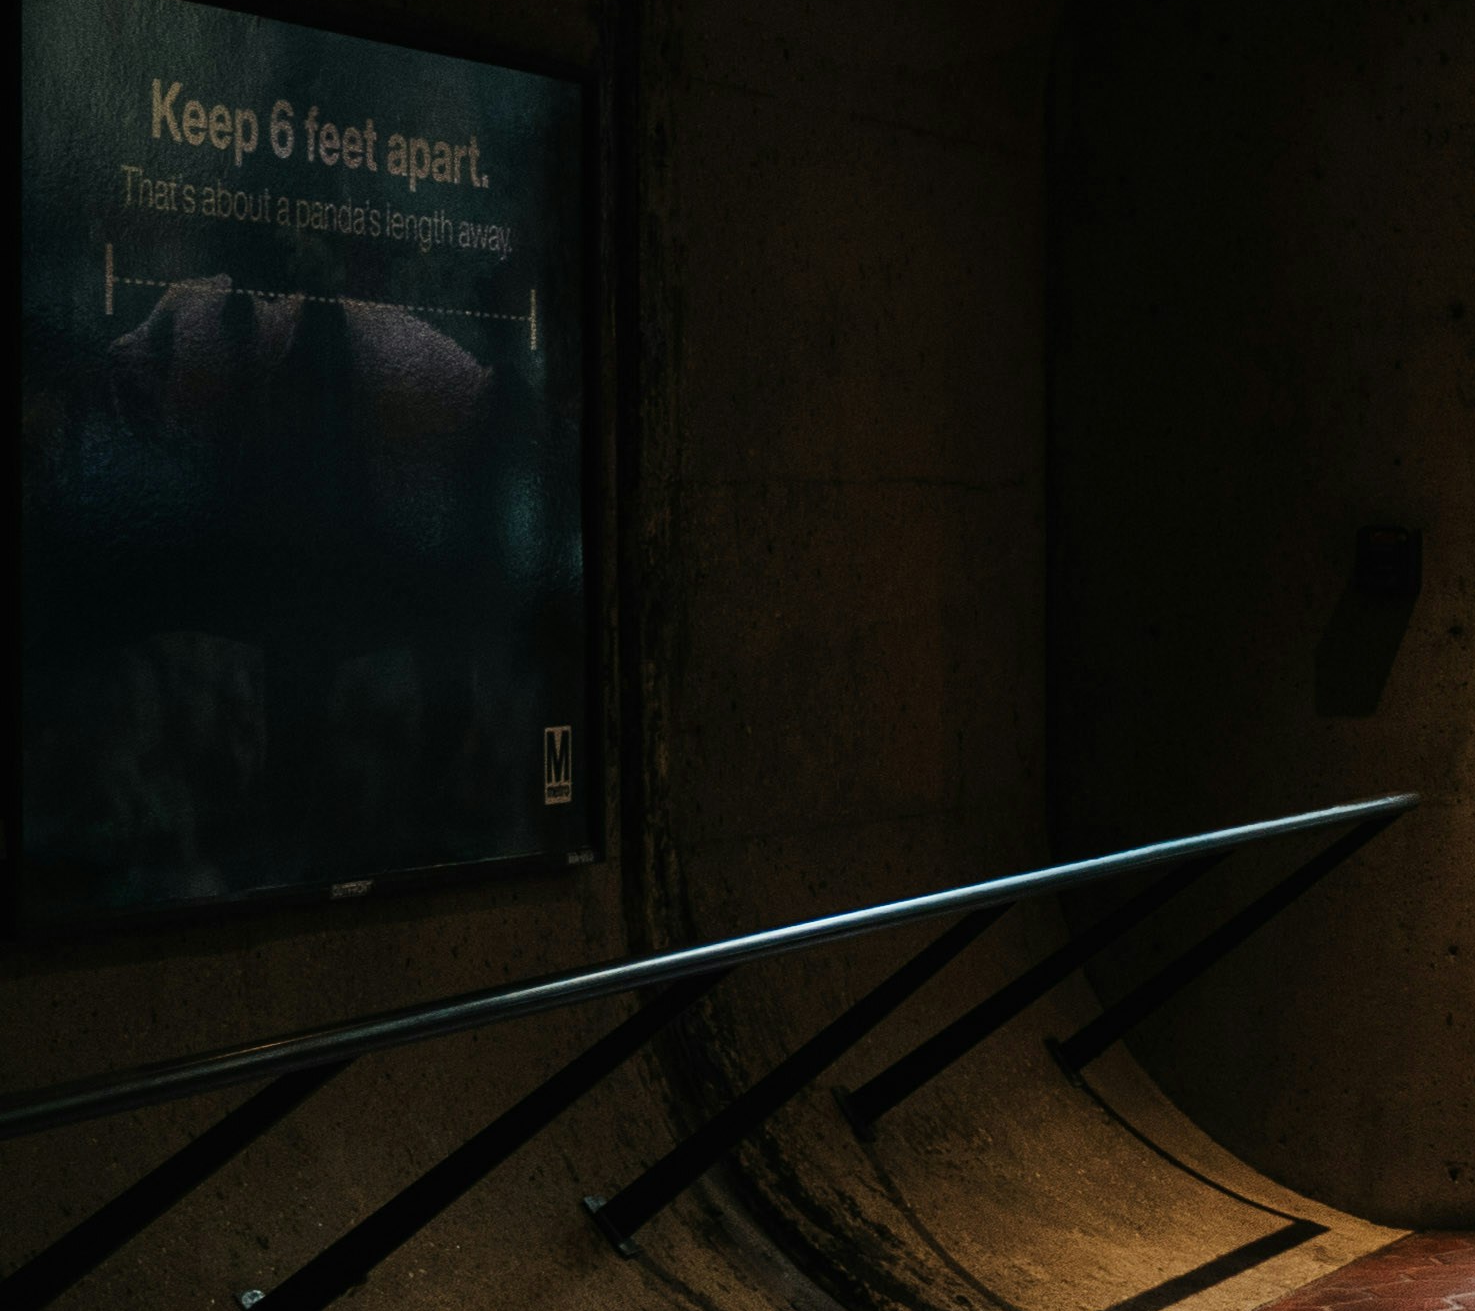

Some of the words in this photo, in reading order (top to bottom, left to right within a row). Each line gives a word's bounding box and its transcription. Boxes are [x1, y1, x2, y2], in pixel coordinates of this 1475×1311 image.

[151, 78, 258, 167] Keep
[270, 100, 295, 159] 6
[305, 105, 378, 171] feet
[386, 131, 490, 192] apart.
[120, 165, 197, 213] That's
[202, 179, 271, 223] about
[276, 198, 291, 225] a
[296, 195, 381, 238] panda's
[386, 205, 453, 252] length
